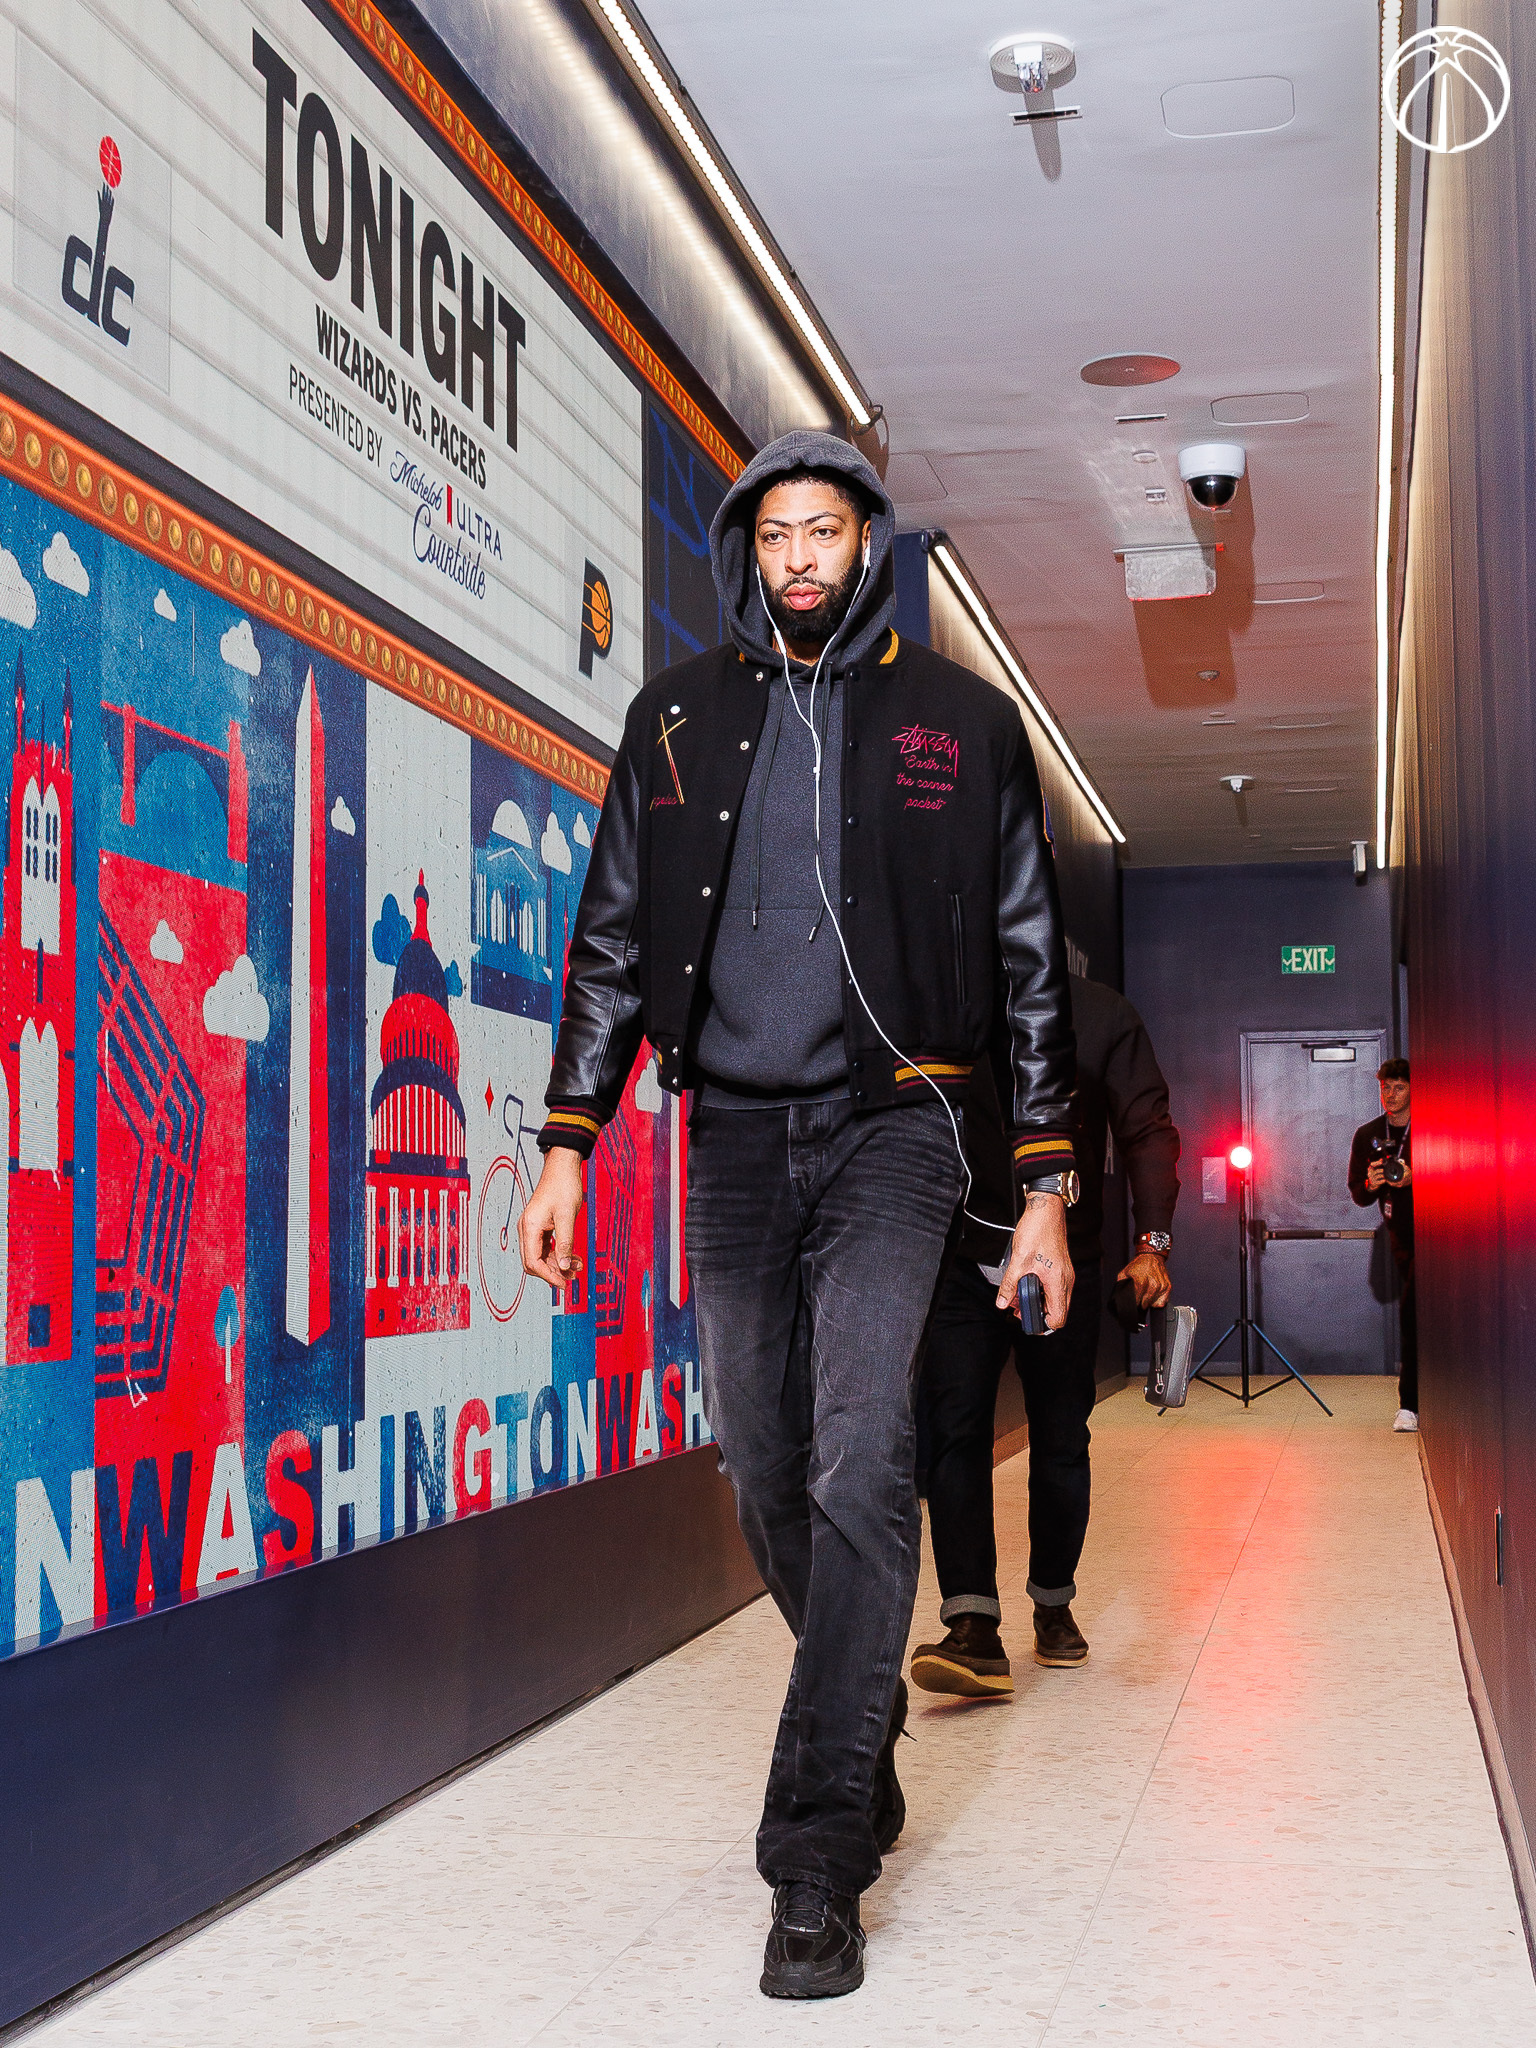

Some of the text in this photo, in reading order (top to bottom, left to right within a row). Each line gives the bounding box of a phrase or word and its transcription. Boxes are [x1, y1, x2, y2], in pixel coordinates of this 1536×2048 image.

[252, 28, 526, 453] TONIGHT
[290, 363, 383, 467] PRESENTED BY
[315, 303, 486, 490] WIZARDS VS. PACERS
[390, 450, 503, 561] Michelob ULTRA
[413, 503, 486, 600] Courtside
[896, 772, 954, 792] the corner
[1291, 948, 1328, 971] EXIT
[95, 1378, 597, 1628] WASHINGTON
